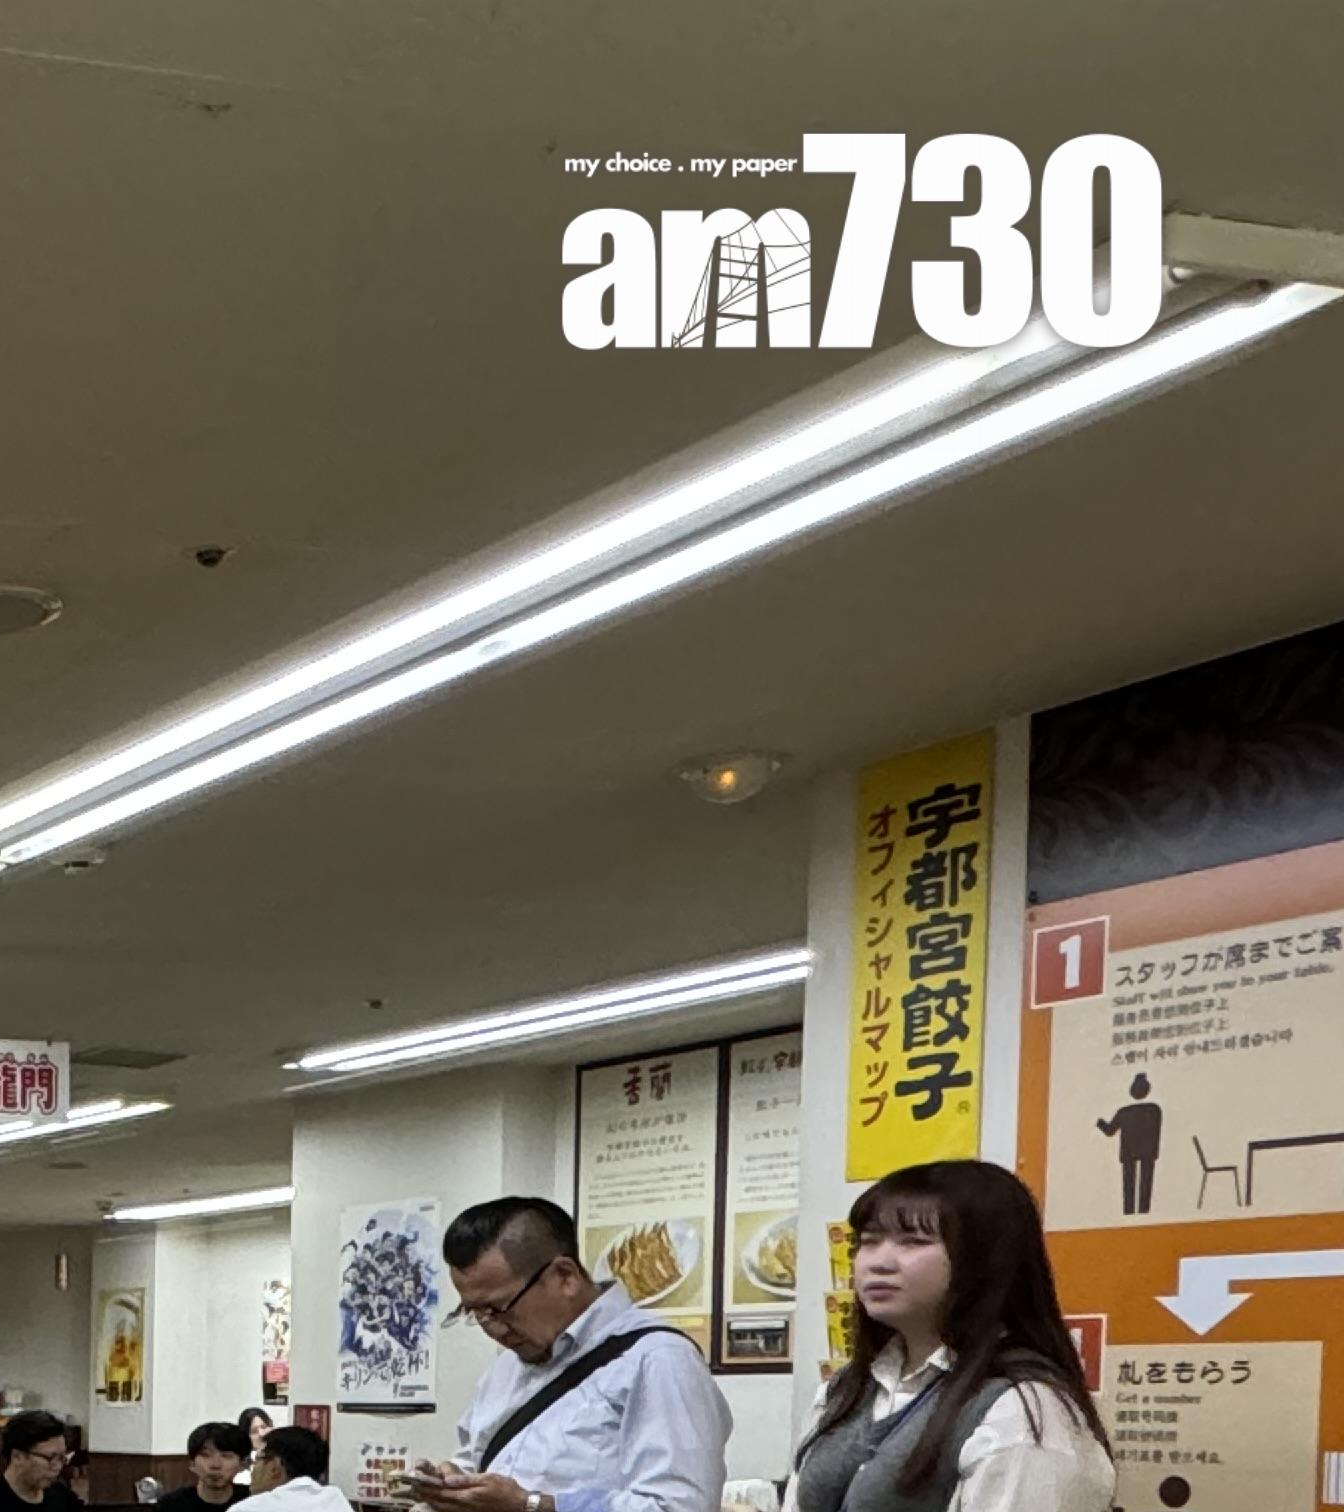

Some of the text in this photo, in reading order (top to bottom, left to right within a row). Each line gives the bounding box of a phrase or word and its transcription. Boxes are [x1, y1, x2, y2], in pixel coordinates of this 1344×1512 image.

[857, 803, 898, 1129] オフィシャルマップ
[894, 783, 983, 1121] 宇都宮餃子
[1058, 933, 1082, 990] 1
[1117, 1360, 1252, 1385] 札をもらう
